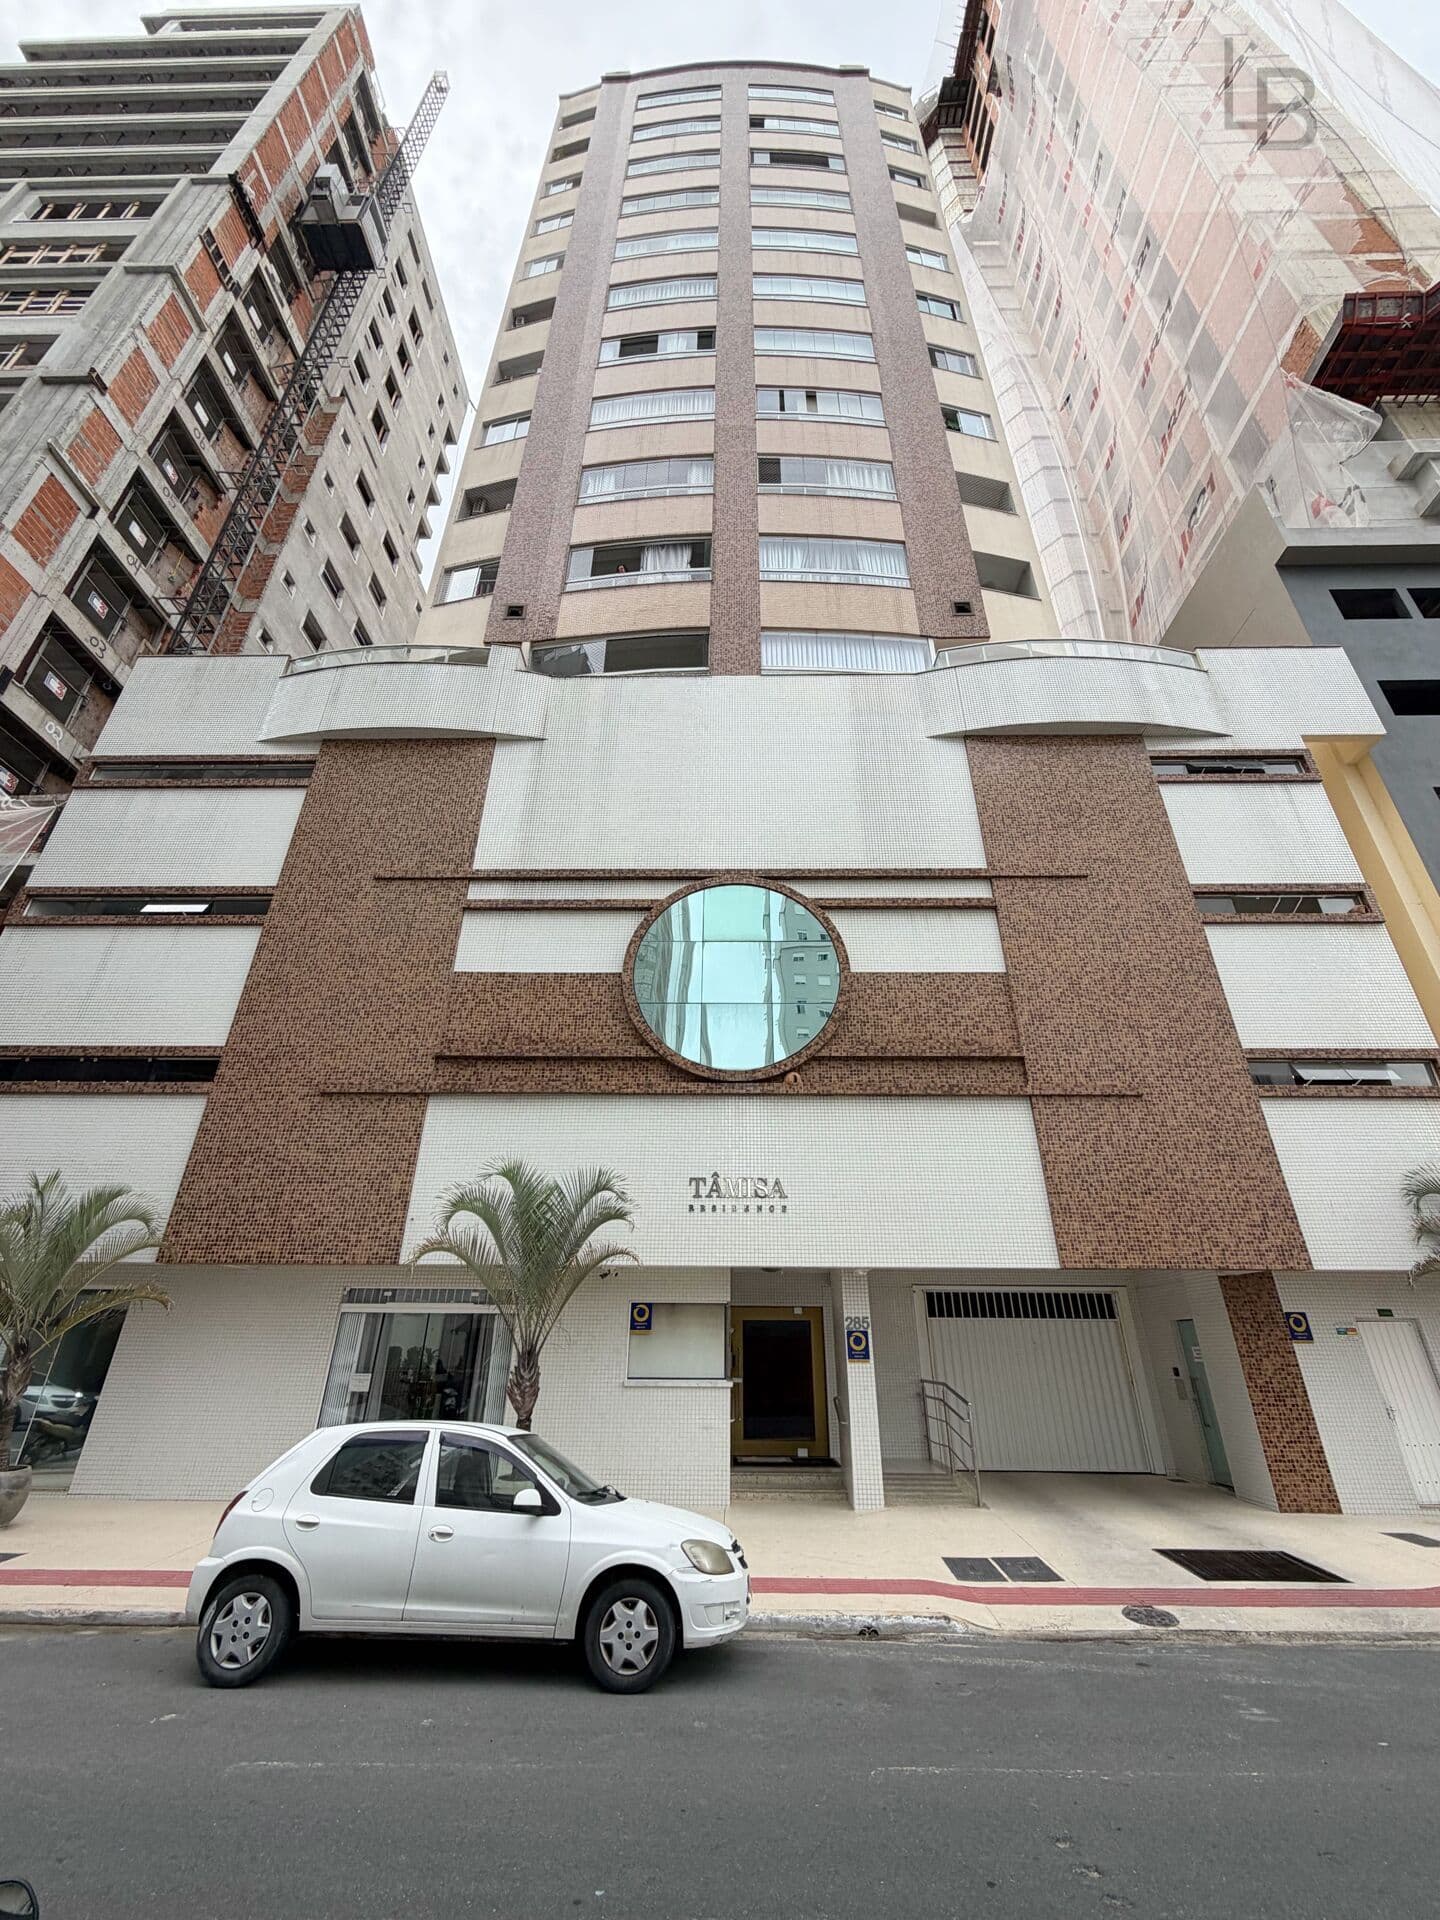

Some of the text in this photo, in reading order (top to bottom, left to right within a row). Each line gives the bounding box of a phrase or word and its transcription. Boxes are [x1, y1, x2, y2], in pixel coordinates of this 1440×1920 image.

[89, 636, 107, 659] 03
[688, 1171, 788, 1199] TÂMISA
[844, 1316, 870, 1330] 285
